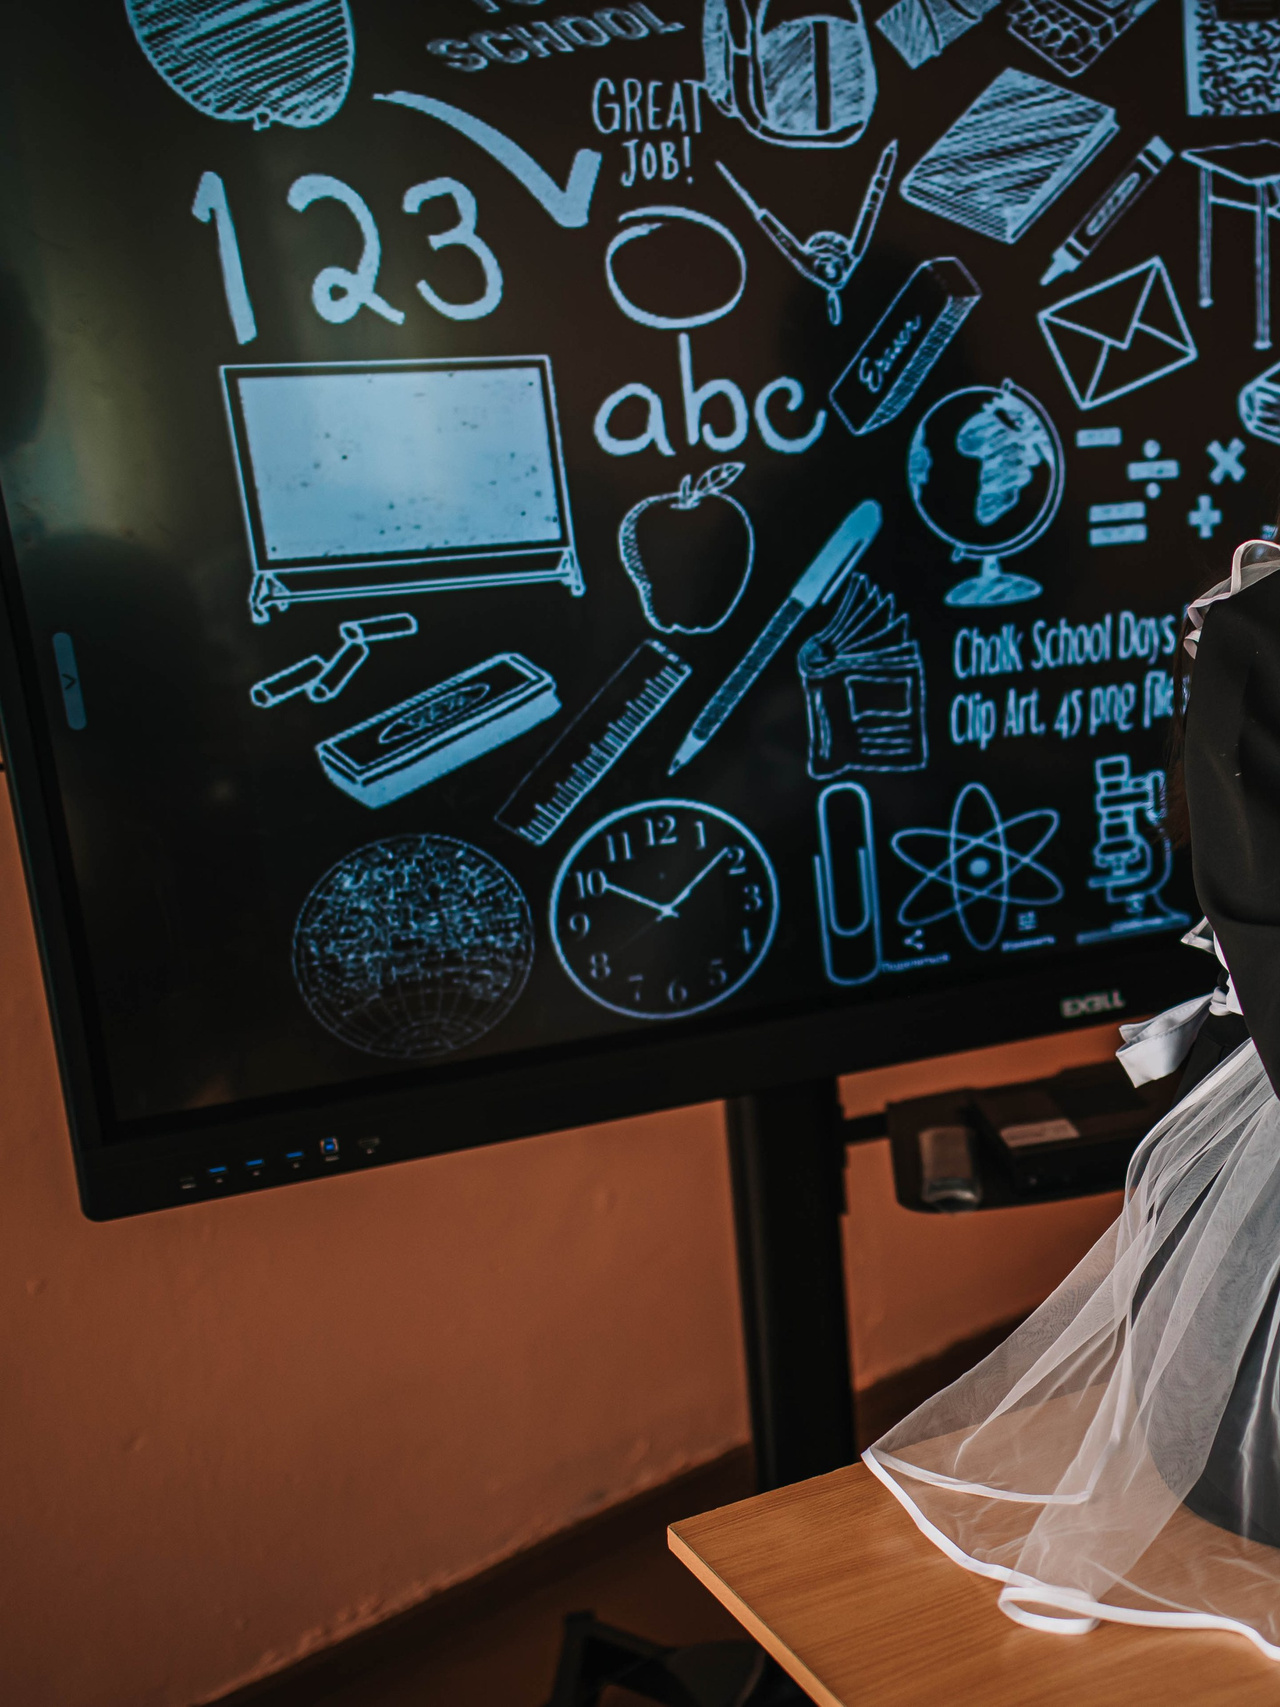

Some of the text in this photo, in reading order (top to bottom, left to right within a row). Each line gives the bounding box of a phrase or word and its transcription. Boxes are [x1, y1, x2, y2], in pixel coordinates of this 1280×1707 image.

[426, 2, 686, 72] SCHOOL
[592, 77, 708, 134] GREAT
[620, 136, 693, 187] JOB!
[593, 332, 828, 456] abc
[953, 610, 1177, 679] Chalk School Days
[950, 693, 997, 751] Clip
[1003, 687, 1046, 738] Art.
[1053, 689, 1083, 739] 45
[1089, 682, 1137, 736] png
[644, 814, 678, 847] 12
[694, 820, 706, 849] 1
[606, 830, 634, 862] 11
[726, 846, 747, 875] 2
[576, 869, 608, 898] 10
[743, 884, 764, 911] 3
[569, 912, 591, 940] 9
[590, 951, 612, 981] 8
[709, 957, 728, 987] 5
[628, 974, 644, 1002] 7
[668, 978, 689, 1004] 6
